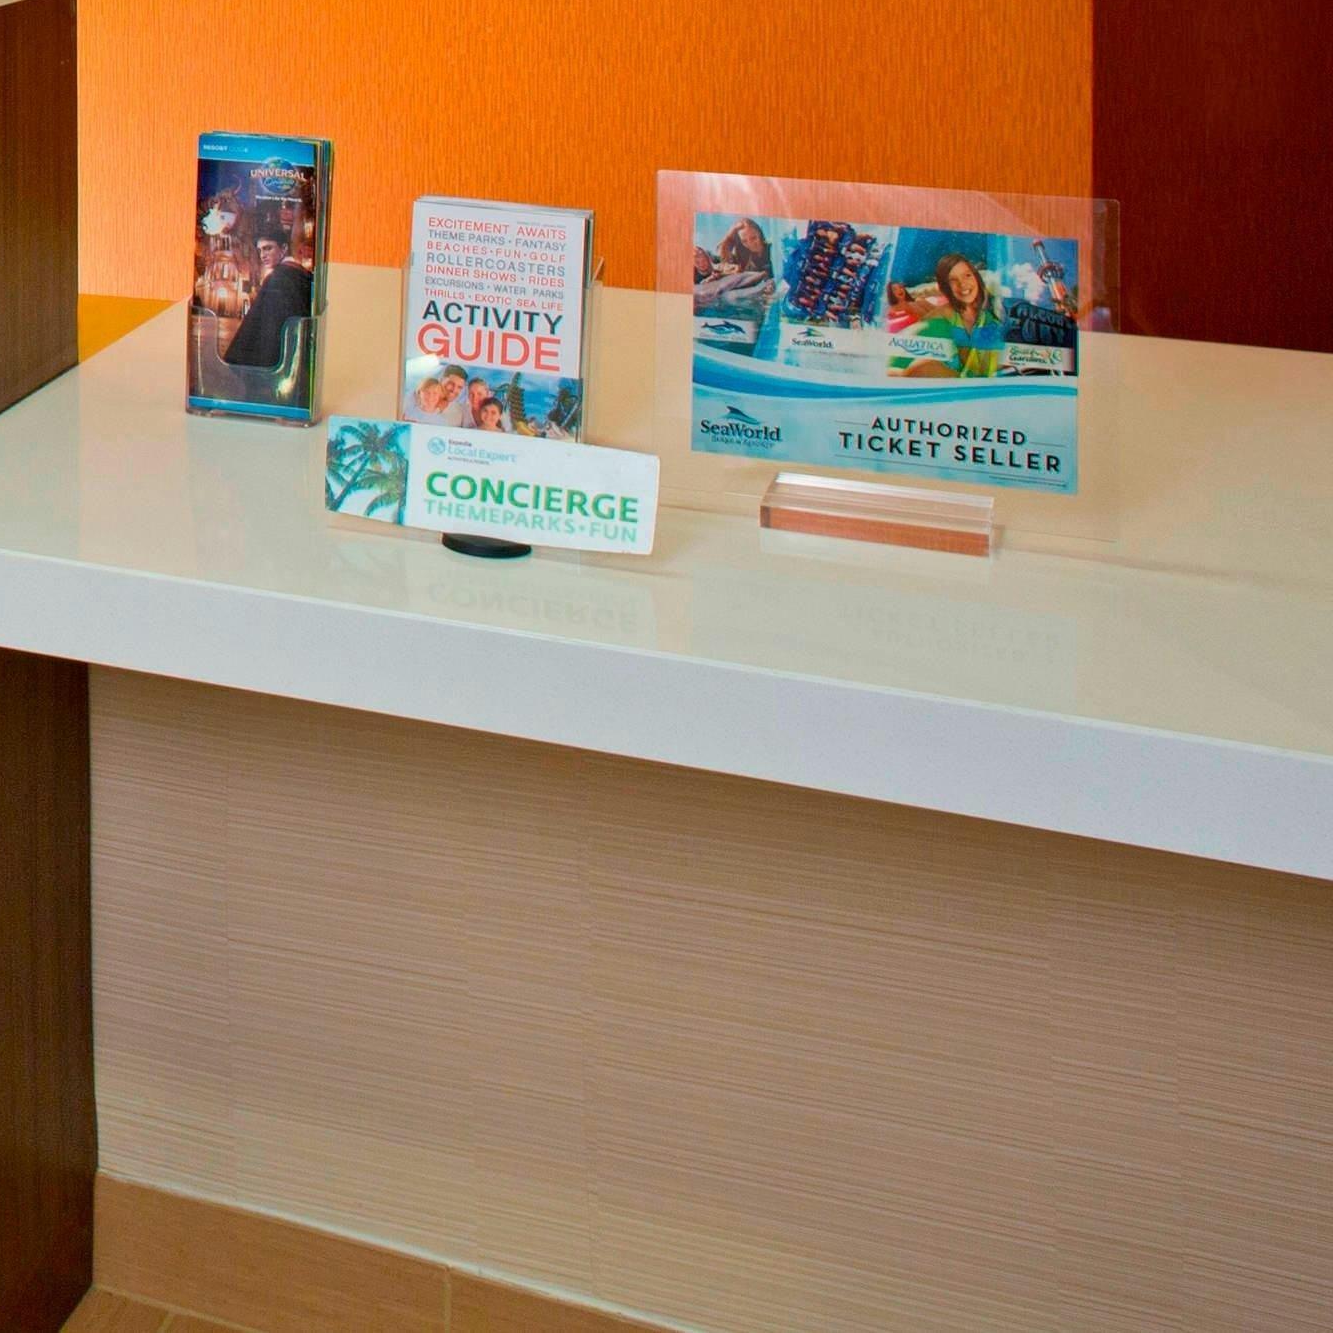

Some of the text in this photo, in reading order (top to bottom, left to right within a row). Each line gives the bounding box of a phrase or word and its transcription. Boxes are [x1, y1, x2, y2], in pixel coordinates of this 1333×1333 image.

[250, 167, 307, 183] UNIVERSAL
[428, 217, 567, 242] EXCITEMENT AWAITS
[429, 229, 567, 254] THEME PARKS FANTASY
[427, 240, 566, 264] BEACHES FUN GOLF
[425, 265, 565, 288] DINNER SHOWS RIDES
[427, 252, 566, 278] ROLLERCOASTERS
[425, 277, 565, 301] EXCURSIONS WATER PARKS
[425, 288, 564, 312] THRILLS EXOTIC SEA LIFE
[422, 299, 564, 336] ACTIVITY
[417, 322, 562, 372] GUIDE
[790, 337, 834, 350] SeaWorld
[888, 336, 945, 352] AQUATICA
[448, 438, 472, 448] Expedia
[700, 418, 781, 443] SeaWorld
[871, 415, 1026, 446] AUTHORIZED
[447, 444, 517, 464] Local Expert
[838, 431, 1062, 473] TICKET SELLER
[425, 471, 639, 524] CONCIERGE
[424, 499, 638, 544] THEMEPARKS FUN
